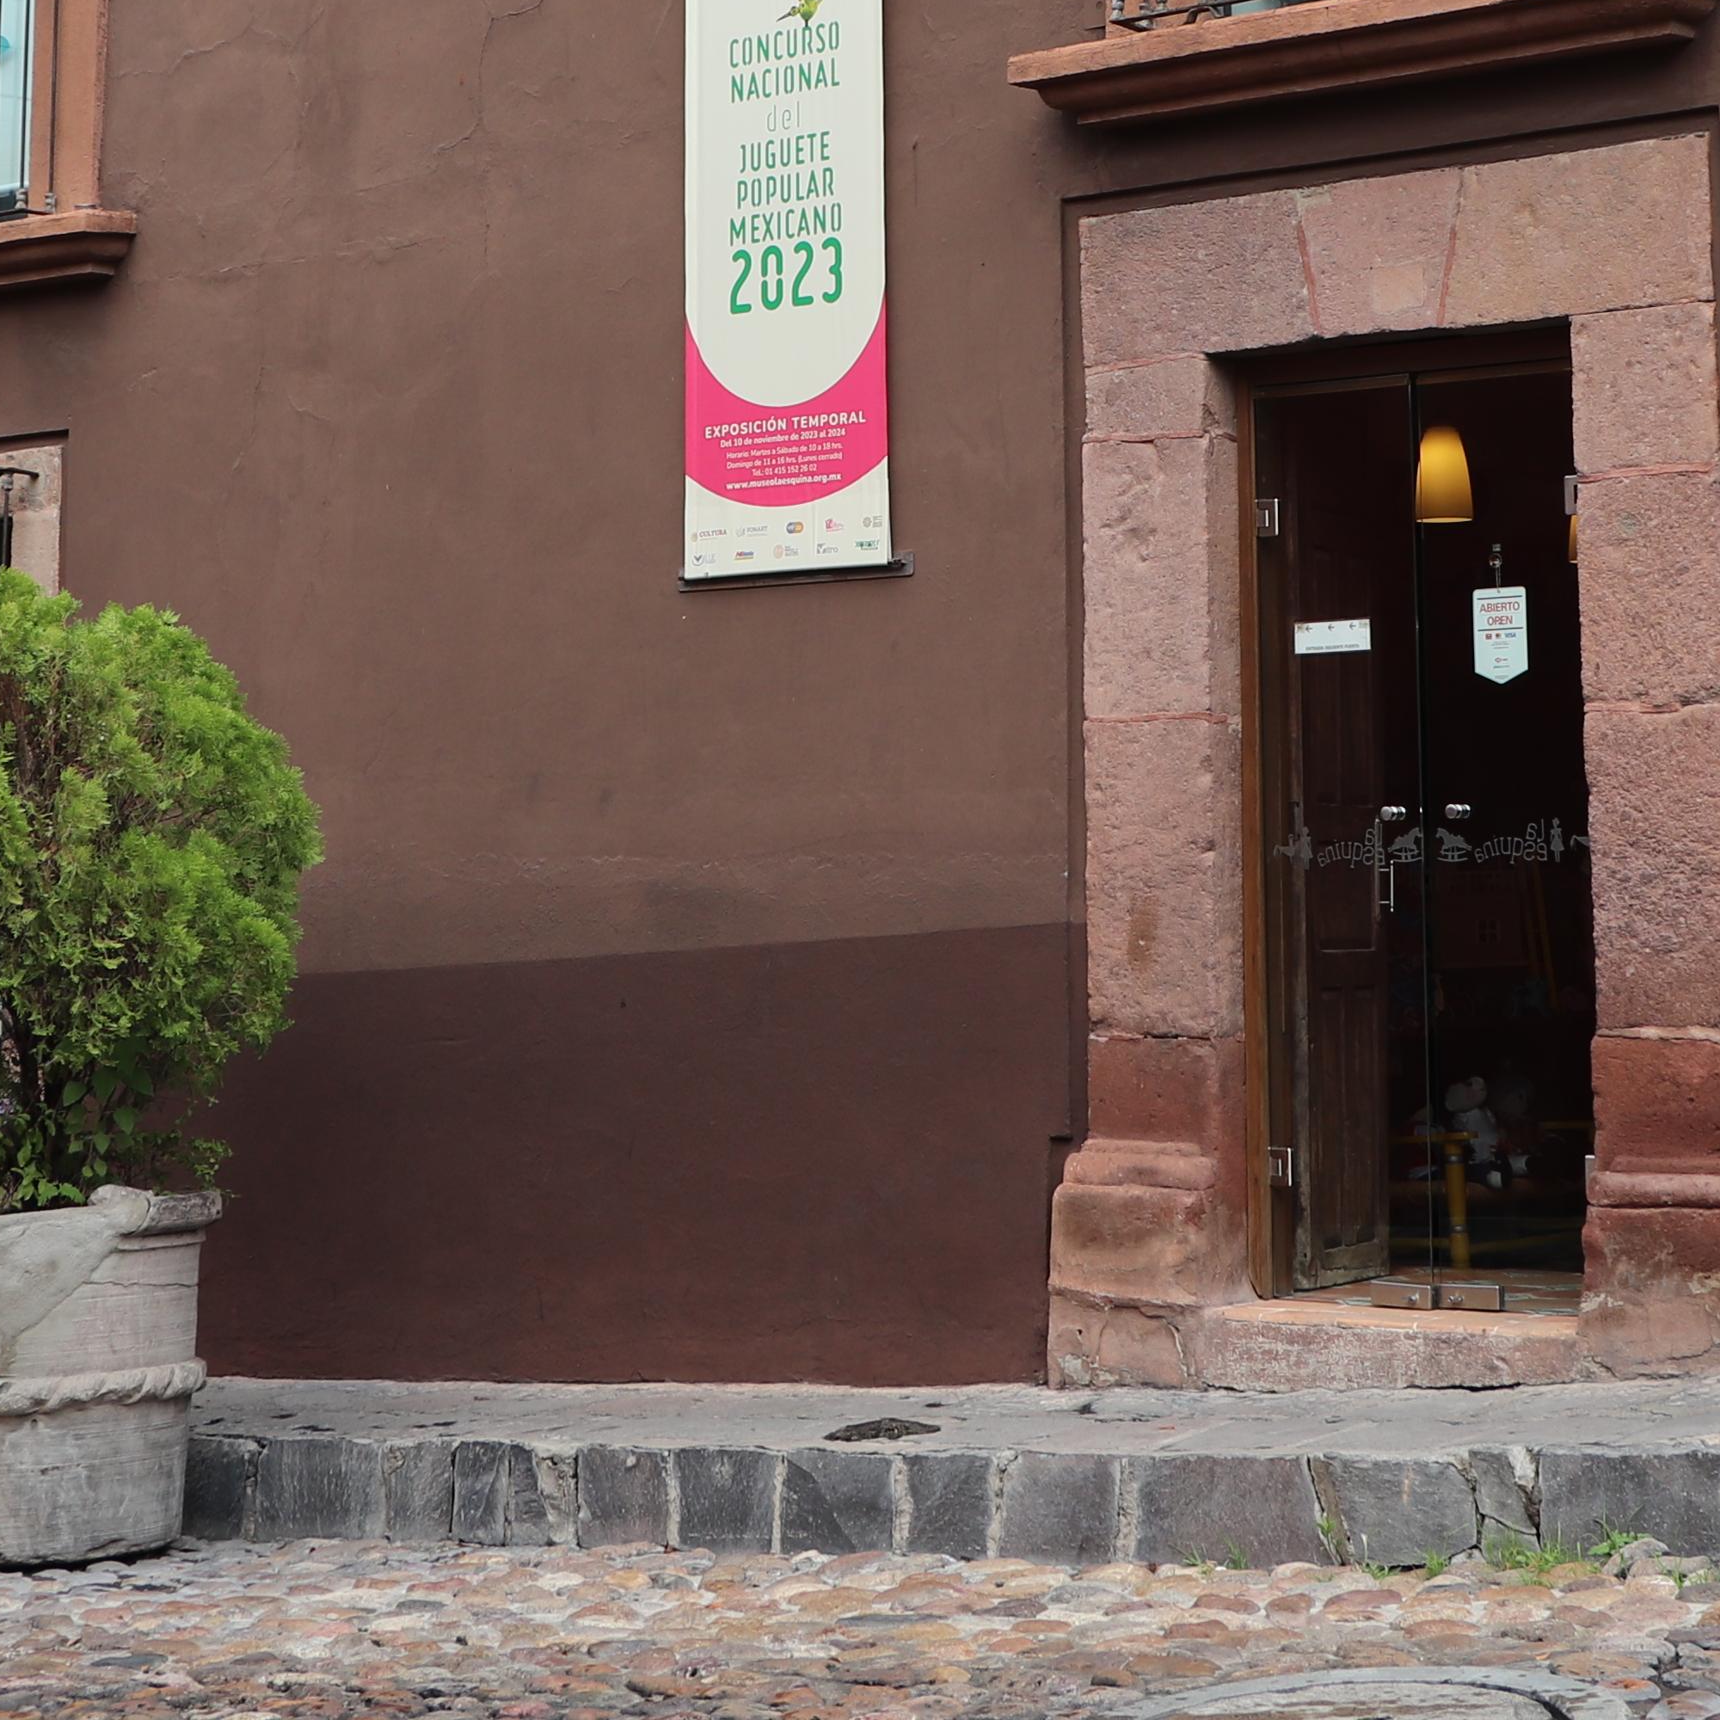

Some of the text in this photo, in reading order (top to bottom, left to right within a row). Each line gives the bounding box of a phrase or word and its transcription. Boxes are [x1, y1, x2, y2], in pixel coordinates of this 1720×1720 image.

[729, 20, 840, 69] CONCURSO
[731, 57, 841, 104] NACIONAL
[766, 100, 801, 132] del
[739, 130, 831, 174] JUGUETE
[736, 166, 835, 210] POPULAR
[729, 202, 842, 247] MEXICANO
[730, 236, 843, 315] 2023
[705, 410, 866, 439] EXPOSICIÓN TEMPORAL
[720, 439, 732, 448] Del
[734, 437, 743, 447] 10
[743, 436, 752, 445] de
[753, 433, 789, 444] noviembre
[790, 433, 799, 441] de
[800, 430, 818, 440] 2023
[726, 473, 842, 490] www.museolaesquina.org.mx
[1480, 601, 1520, 613] ABIERTO
[1486, 615, 1513, 626] OPEN
